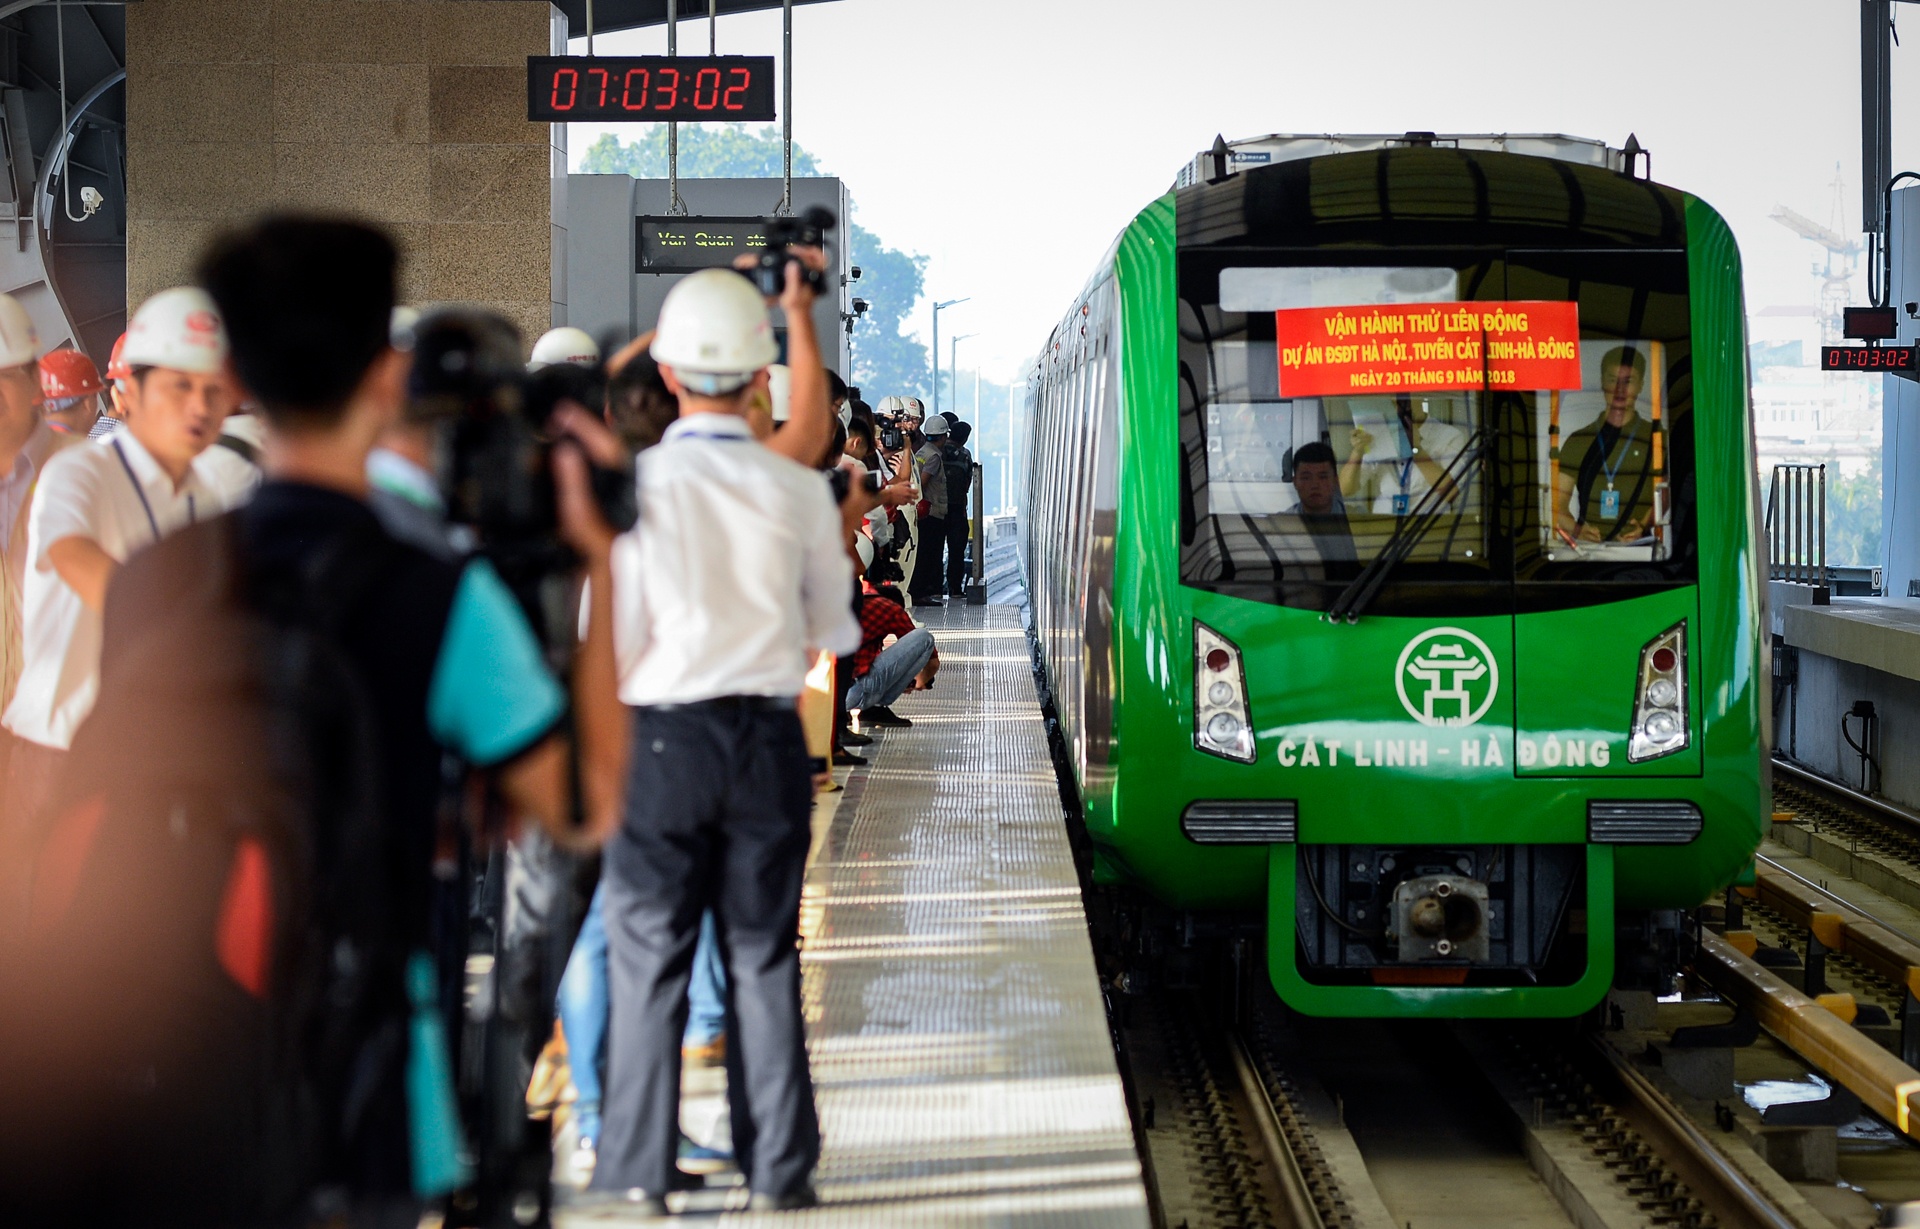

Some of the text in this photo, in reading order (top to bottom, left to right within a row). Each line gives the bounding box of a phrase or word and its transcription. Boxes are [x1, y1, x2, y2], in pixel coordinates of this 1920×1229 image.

[551, 68, 751, 110] 07:03:02
[658, 232, 687, 246] Van
[695, 232, 734, 247] Quan
[1325, 307, 1528, 340] VẬN HÀNH THỬ LIÊN ĐỘNG
[1283, 345, 1303, 370] DỰ
[1304, 341, 1323, 365] ÁN
[1325, 345, 1360, 364] ĐSĐT
[1361, 338, 1380, 362] HÀ
[1456, 336, 1481, 359] CÁT
[1538, 336, 1575, 359] ĐÔNG
[1829, 350, 1909, 367] 07:03:02
[1350, 369, 1384, 387] NGÀY
[1386, 372, 1401, 386] 20
[1402, 367, 1444, 385] THÁNG
[1446, 371, 1455, 384] 9
[1456, 366, 1483, 383] NĂM
[1277, 733, 1342, 768] CÁT
[1355, 739, 1428, 767] LINH
[1461, 733, 1504, 767] HÀ
[1518, 733, 1610, 768] ĐÔNG
